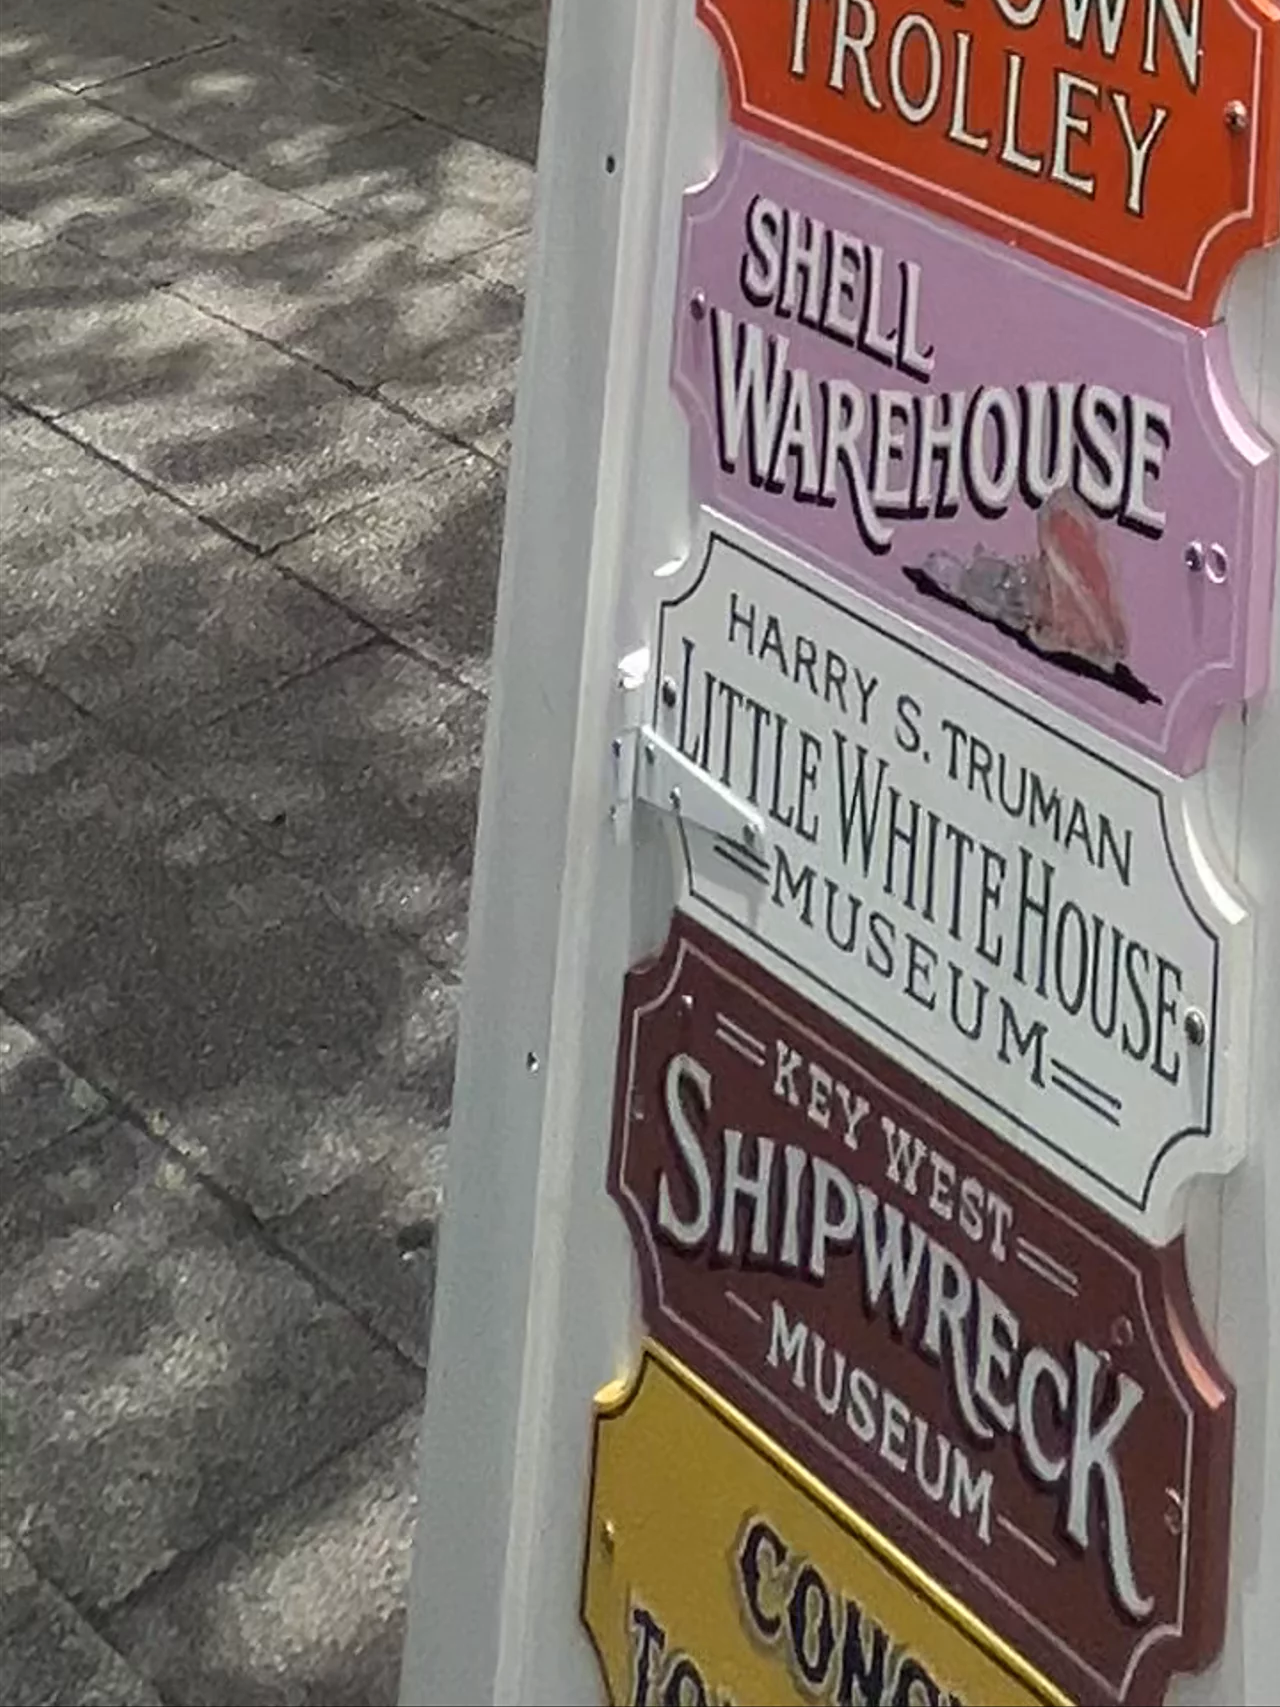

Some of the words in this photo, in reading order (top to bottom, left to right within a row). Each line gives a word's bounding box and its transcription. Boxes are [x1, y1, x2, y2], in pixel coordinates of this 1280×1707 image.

[741, 194, 935, 382] SHELL
[711, 308, 1170, 555] WAREHOUSE
[676, 639, 822, 843] LITTLE
[833, 731, 1006, 966] WHITE
[1013, 847, 1183, 1083] HOUSE
[728, 593, 877, 724] HARRY
[895, 696, 930, 762] S.
[941, 719, 1132, 885] TRUMAN
[769, 844, 1047, 1088] MUSEUM
[772, 1040, 870, 1151] KEY
[881, 1117, 1017, 1261] WEST
[657, 1053, 1154, 1621] SHIPWRECK
[766, 1300, 994, 1542] MUSEUM
